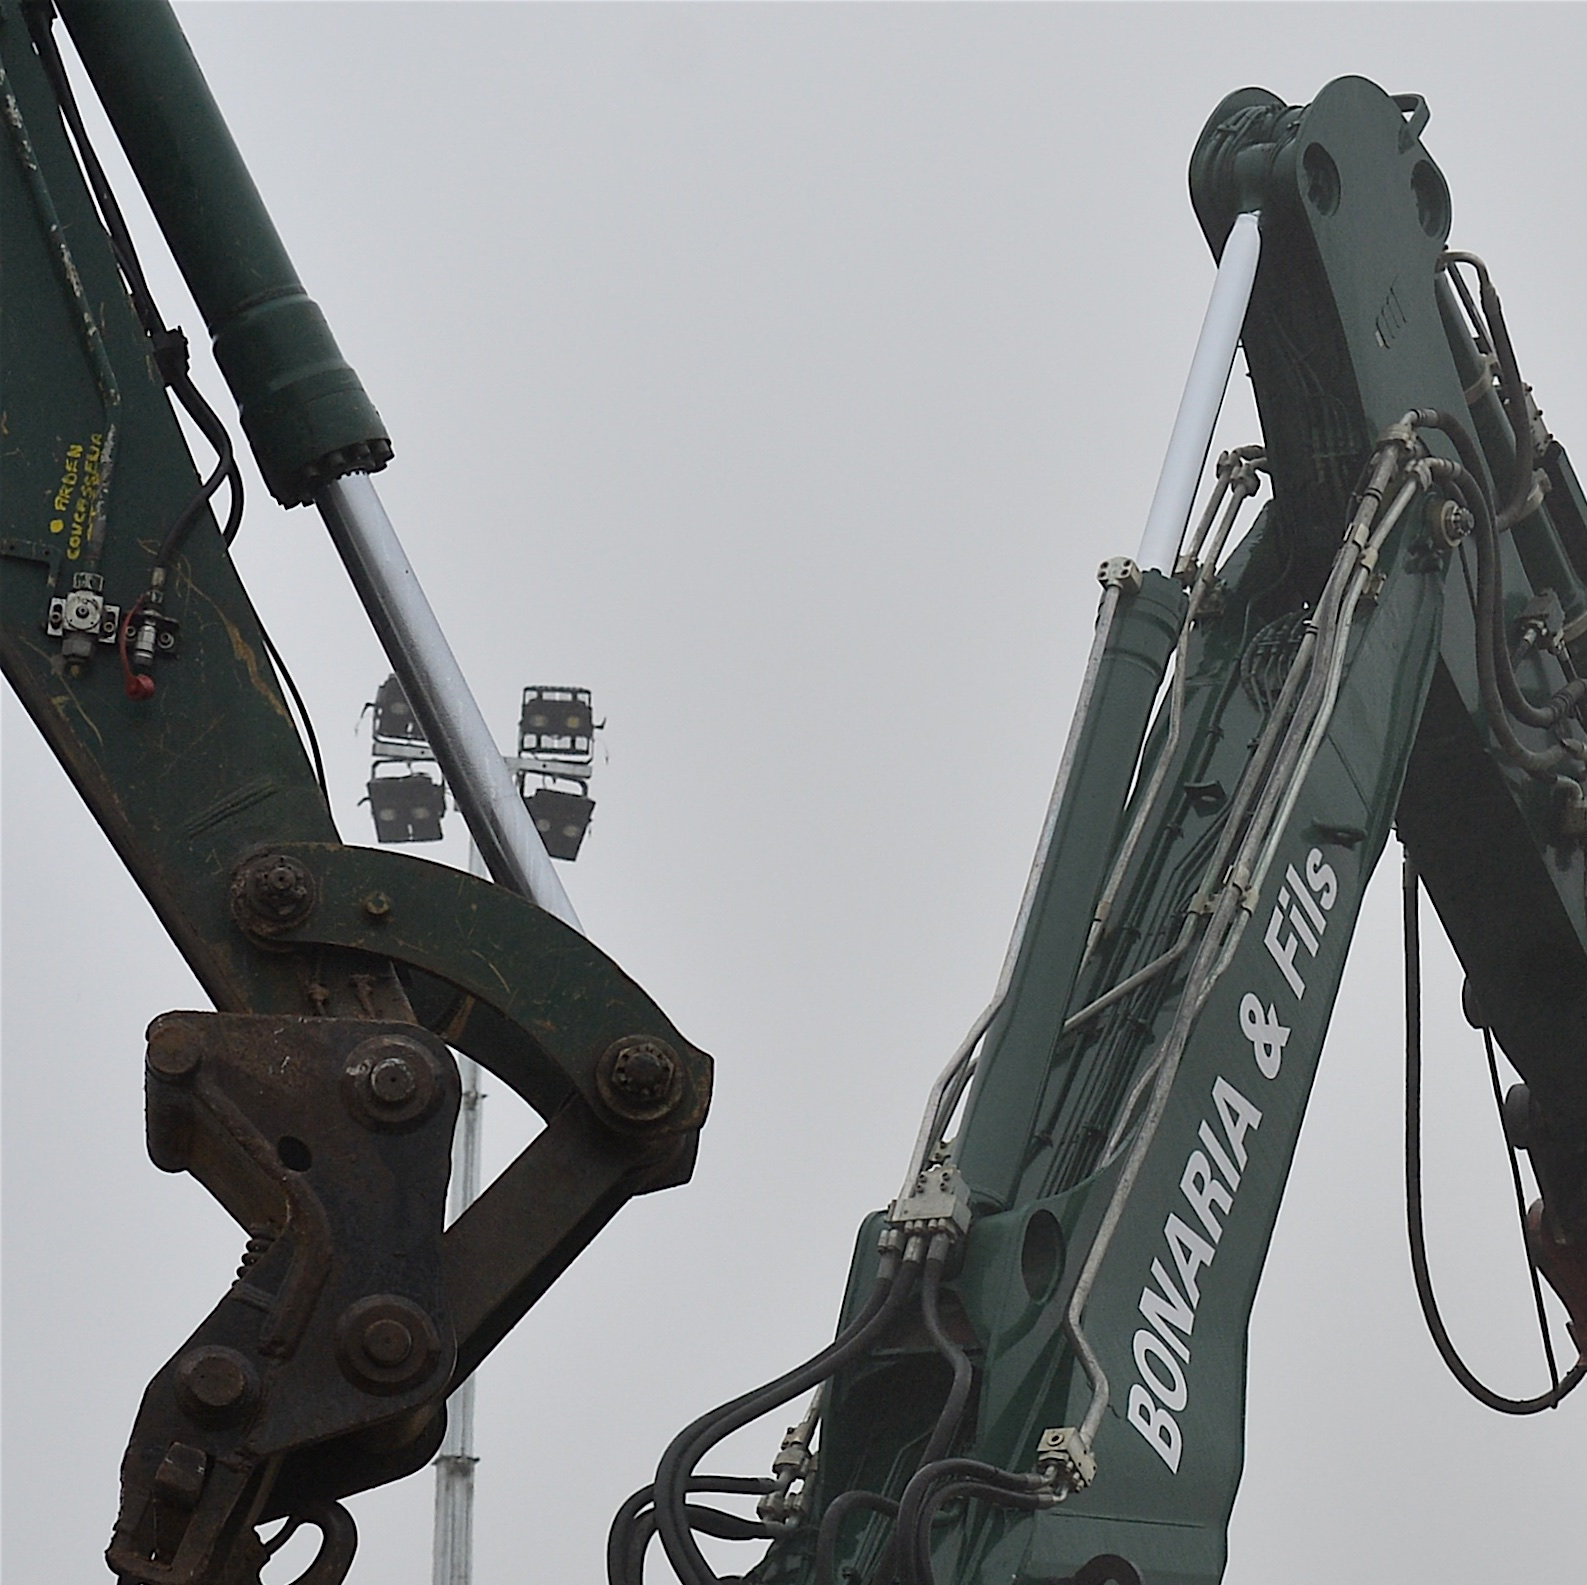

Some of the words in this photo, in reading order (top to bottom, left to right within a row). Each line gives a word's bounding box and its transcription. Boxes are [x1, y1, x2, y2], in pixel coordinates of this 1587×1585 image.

[1264, 847, 1339, 999] Fils
[1240, 992, 1292, 1079] &
[1127, 1077, 1262, 1475] BONARIA
